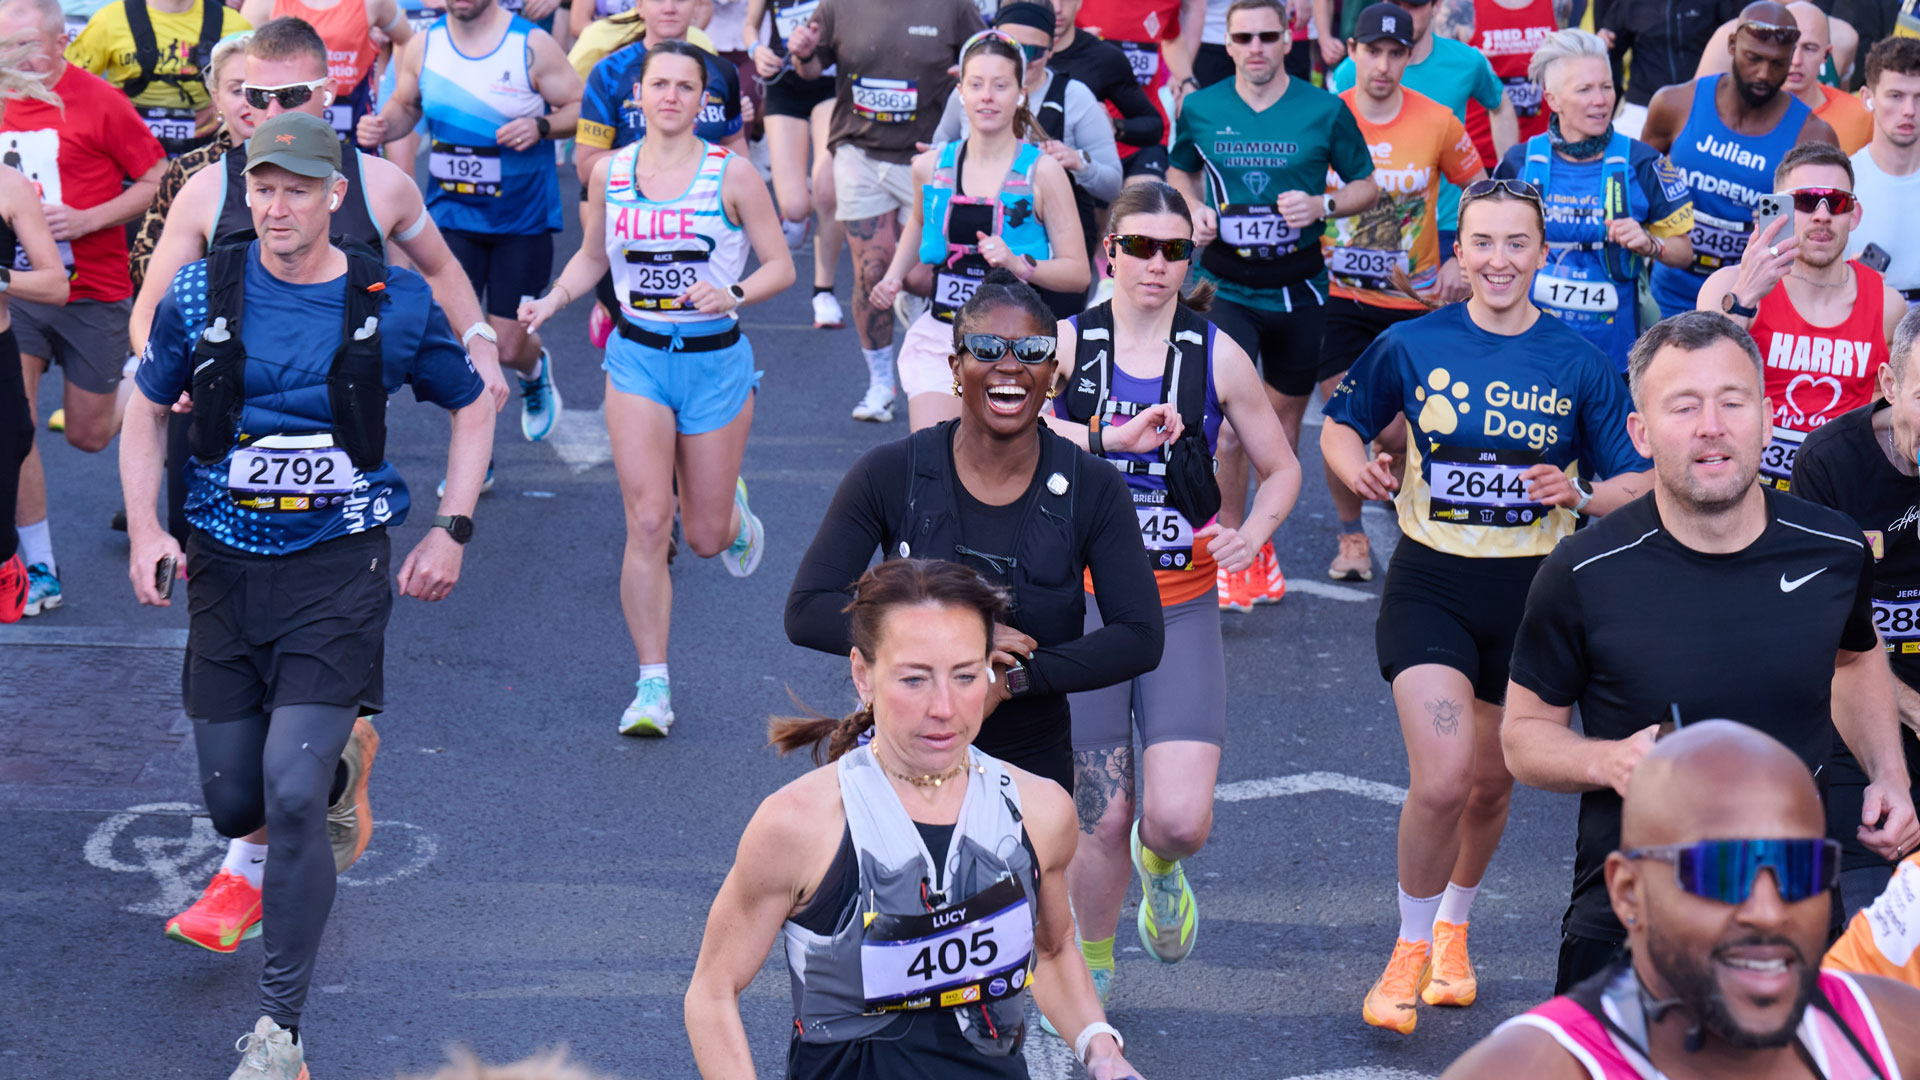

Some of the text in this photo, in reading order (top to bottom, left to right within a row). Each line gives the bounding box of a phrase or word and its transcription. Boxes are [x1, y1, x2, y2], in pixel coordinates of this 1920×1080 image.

[857, 90, 911, 108] 23869
[583, 122, 612, 138] RBC
[1214, 141, 1299, 155] DIAMOND
[1696, 134, 1766, 171] Julian
[446, 159, 483, 178] 192
[1224, 156, 1288, 168] RUNNERS
[1554, 193, 1578, 206] Bank
[614, 206, 696, 241] ALICE
[1233, 220, 1291, 240] 1475
[653, 253, 674, 262] ALICE
[639, 266, 698, 291] 2593
[1550, 283, 1607, 307] 1714
[1766, 331, 1872, 378] HARRY
[1484, 380, 1573, 417] Guide
[1482, 409, 1559, 450] Dogs
[1478, 451, 1497, 462] JEM
[1762, 445, 1797, 472] 35
[248, 456, 335, 485] 2792
[1445, 469, 1527, 499] 2644
[1138, 515, 1180, 542] 45
[1896, 589, 1920, 598] JERE
[1874, 606, 1920, 633] 28
[932, 908, 967, 928] LUCY
[906, 927, 999, 981] 405
